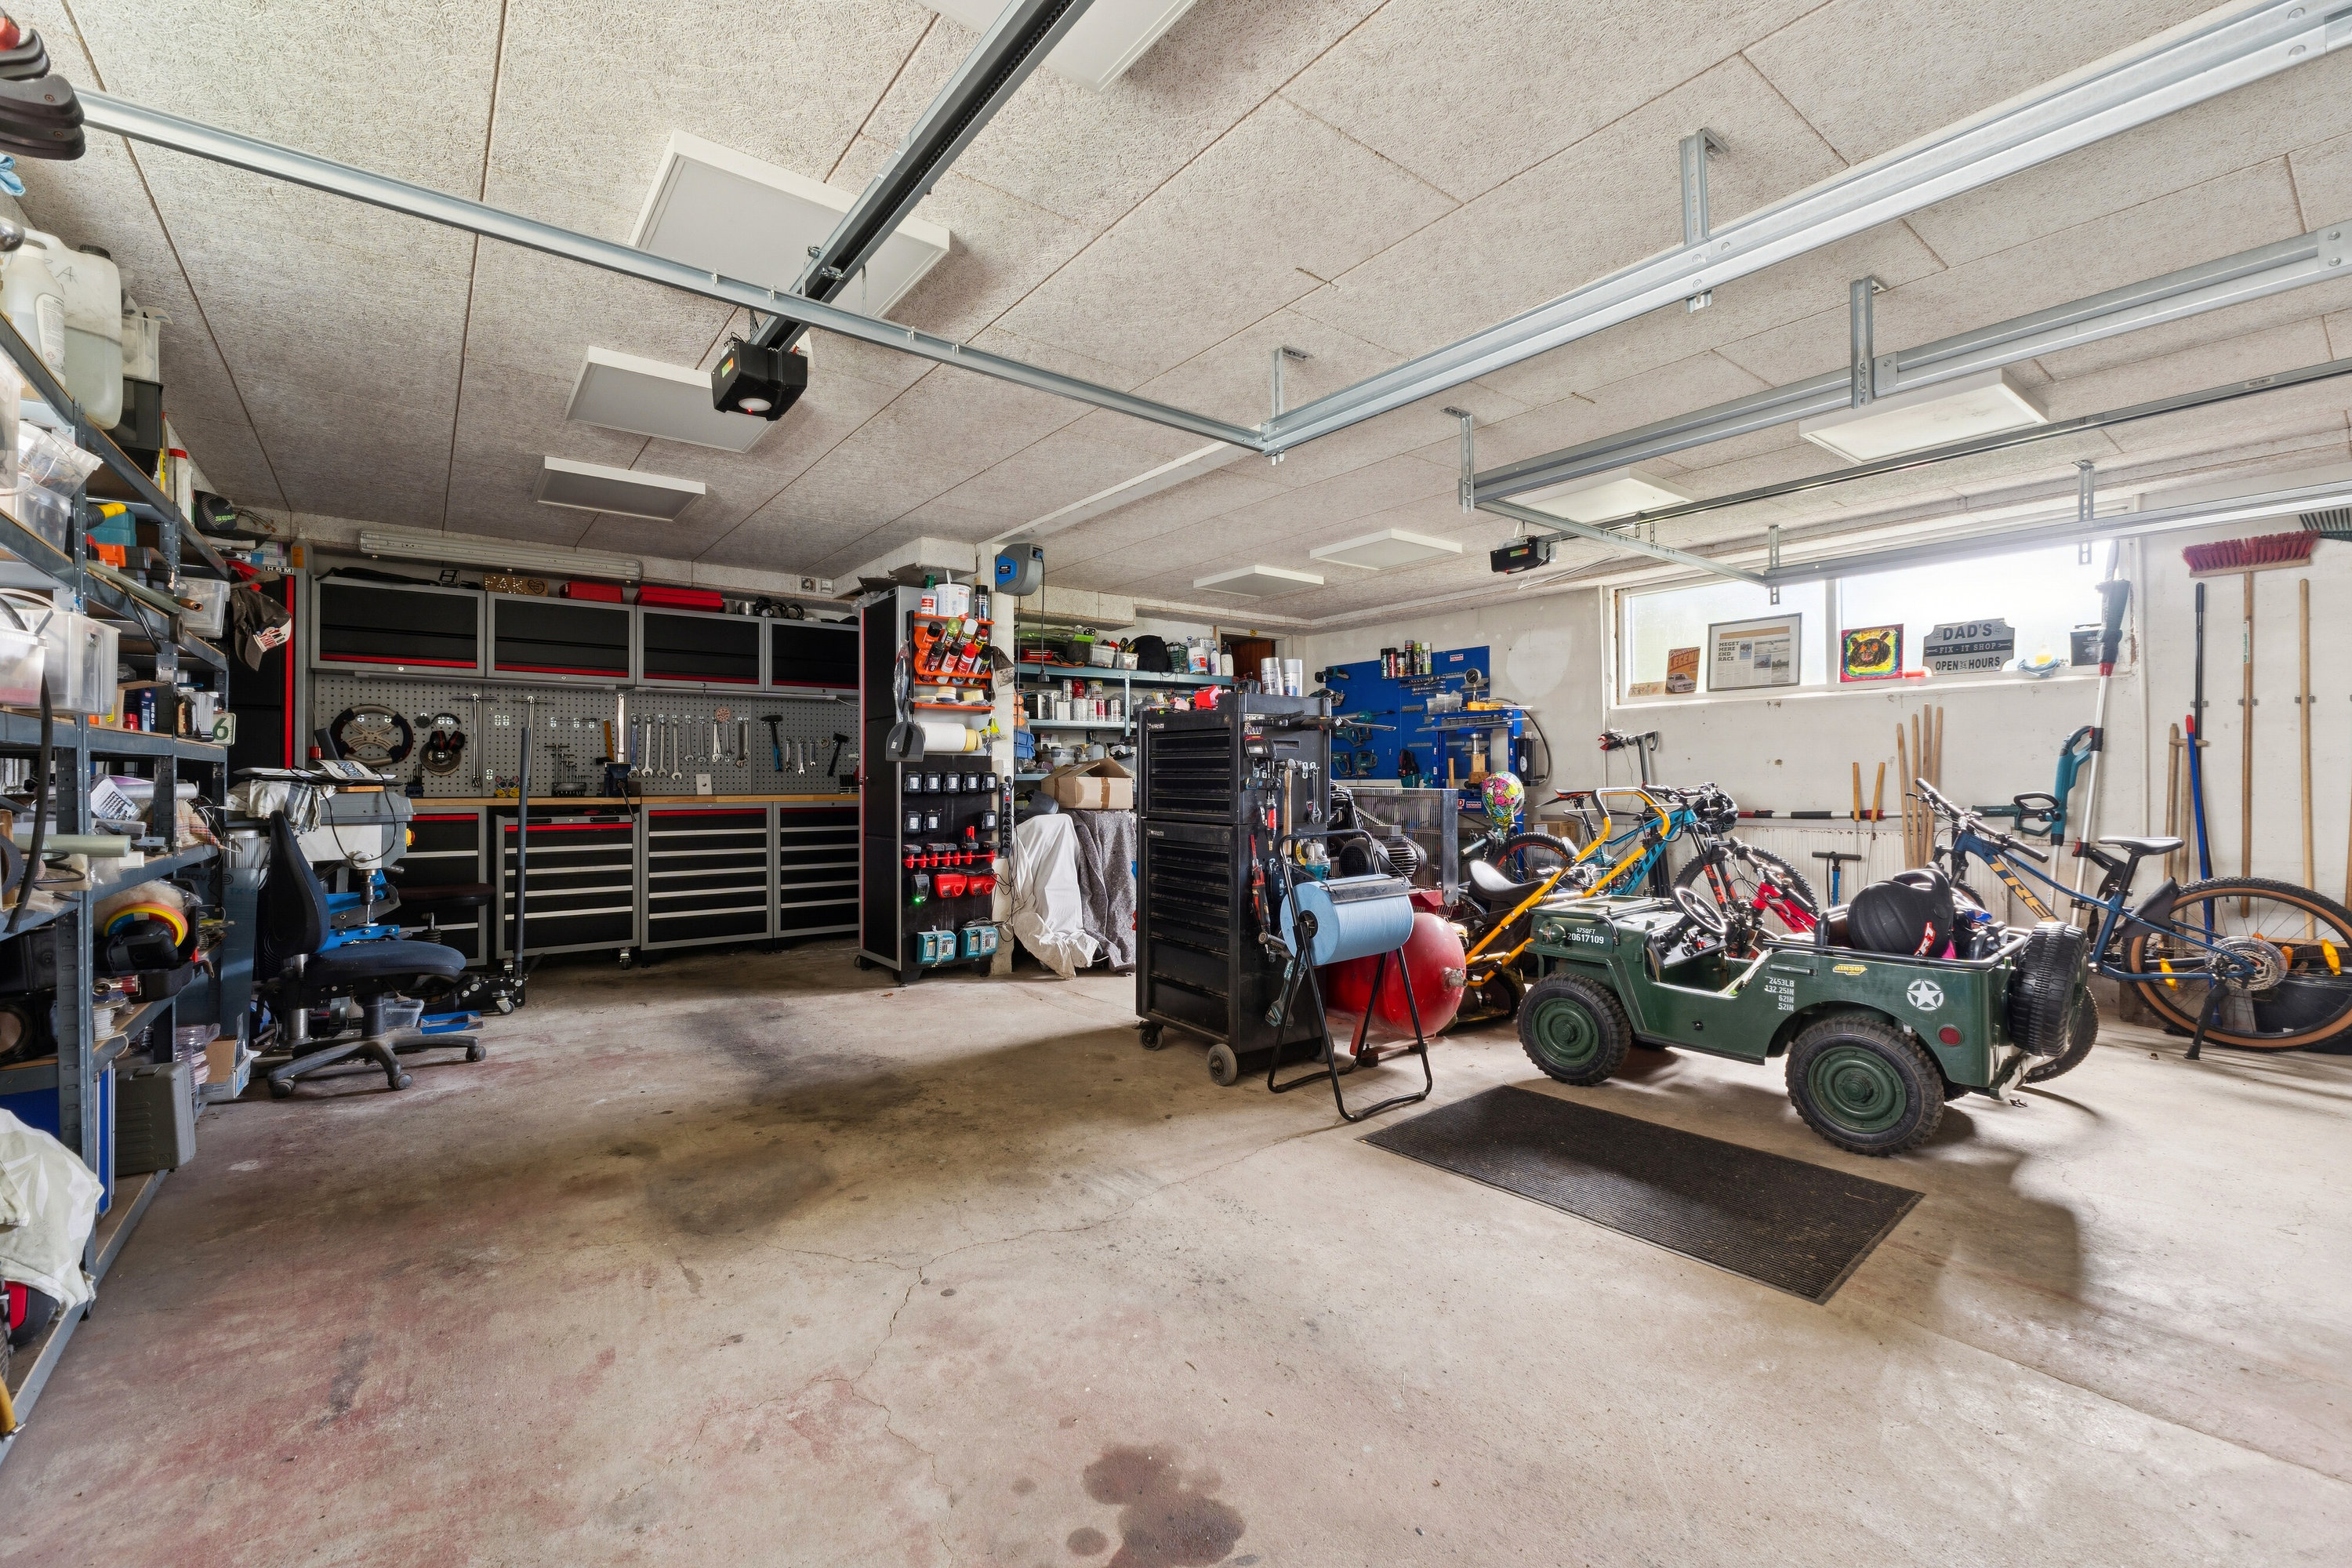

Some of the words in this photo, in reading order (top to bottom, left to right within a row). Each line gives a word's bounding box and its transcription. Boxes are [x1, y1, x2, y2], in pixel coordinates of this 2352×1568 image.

[1943, 622, 1992, 641] DAD'S
[1973, 643, 1997, 652] SHOP
[1935, 660, 1958, 670] OPEN
[1969, 656, 2001, 670] HOURS
[212, 717, 229, 741] 6
[1567, 932, 1605, 944] 20617109
[1769, 977, 1795, 987] 2453LB
[1765, 985, 1795, 996] 132.25IN
[1778, 994, 1795, 1004] 62IN
[1777, 1002, 1795, 1011] 52IN
